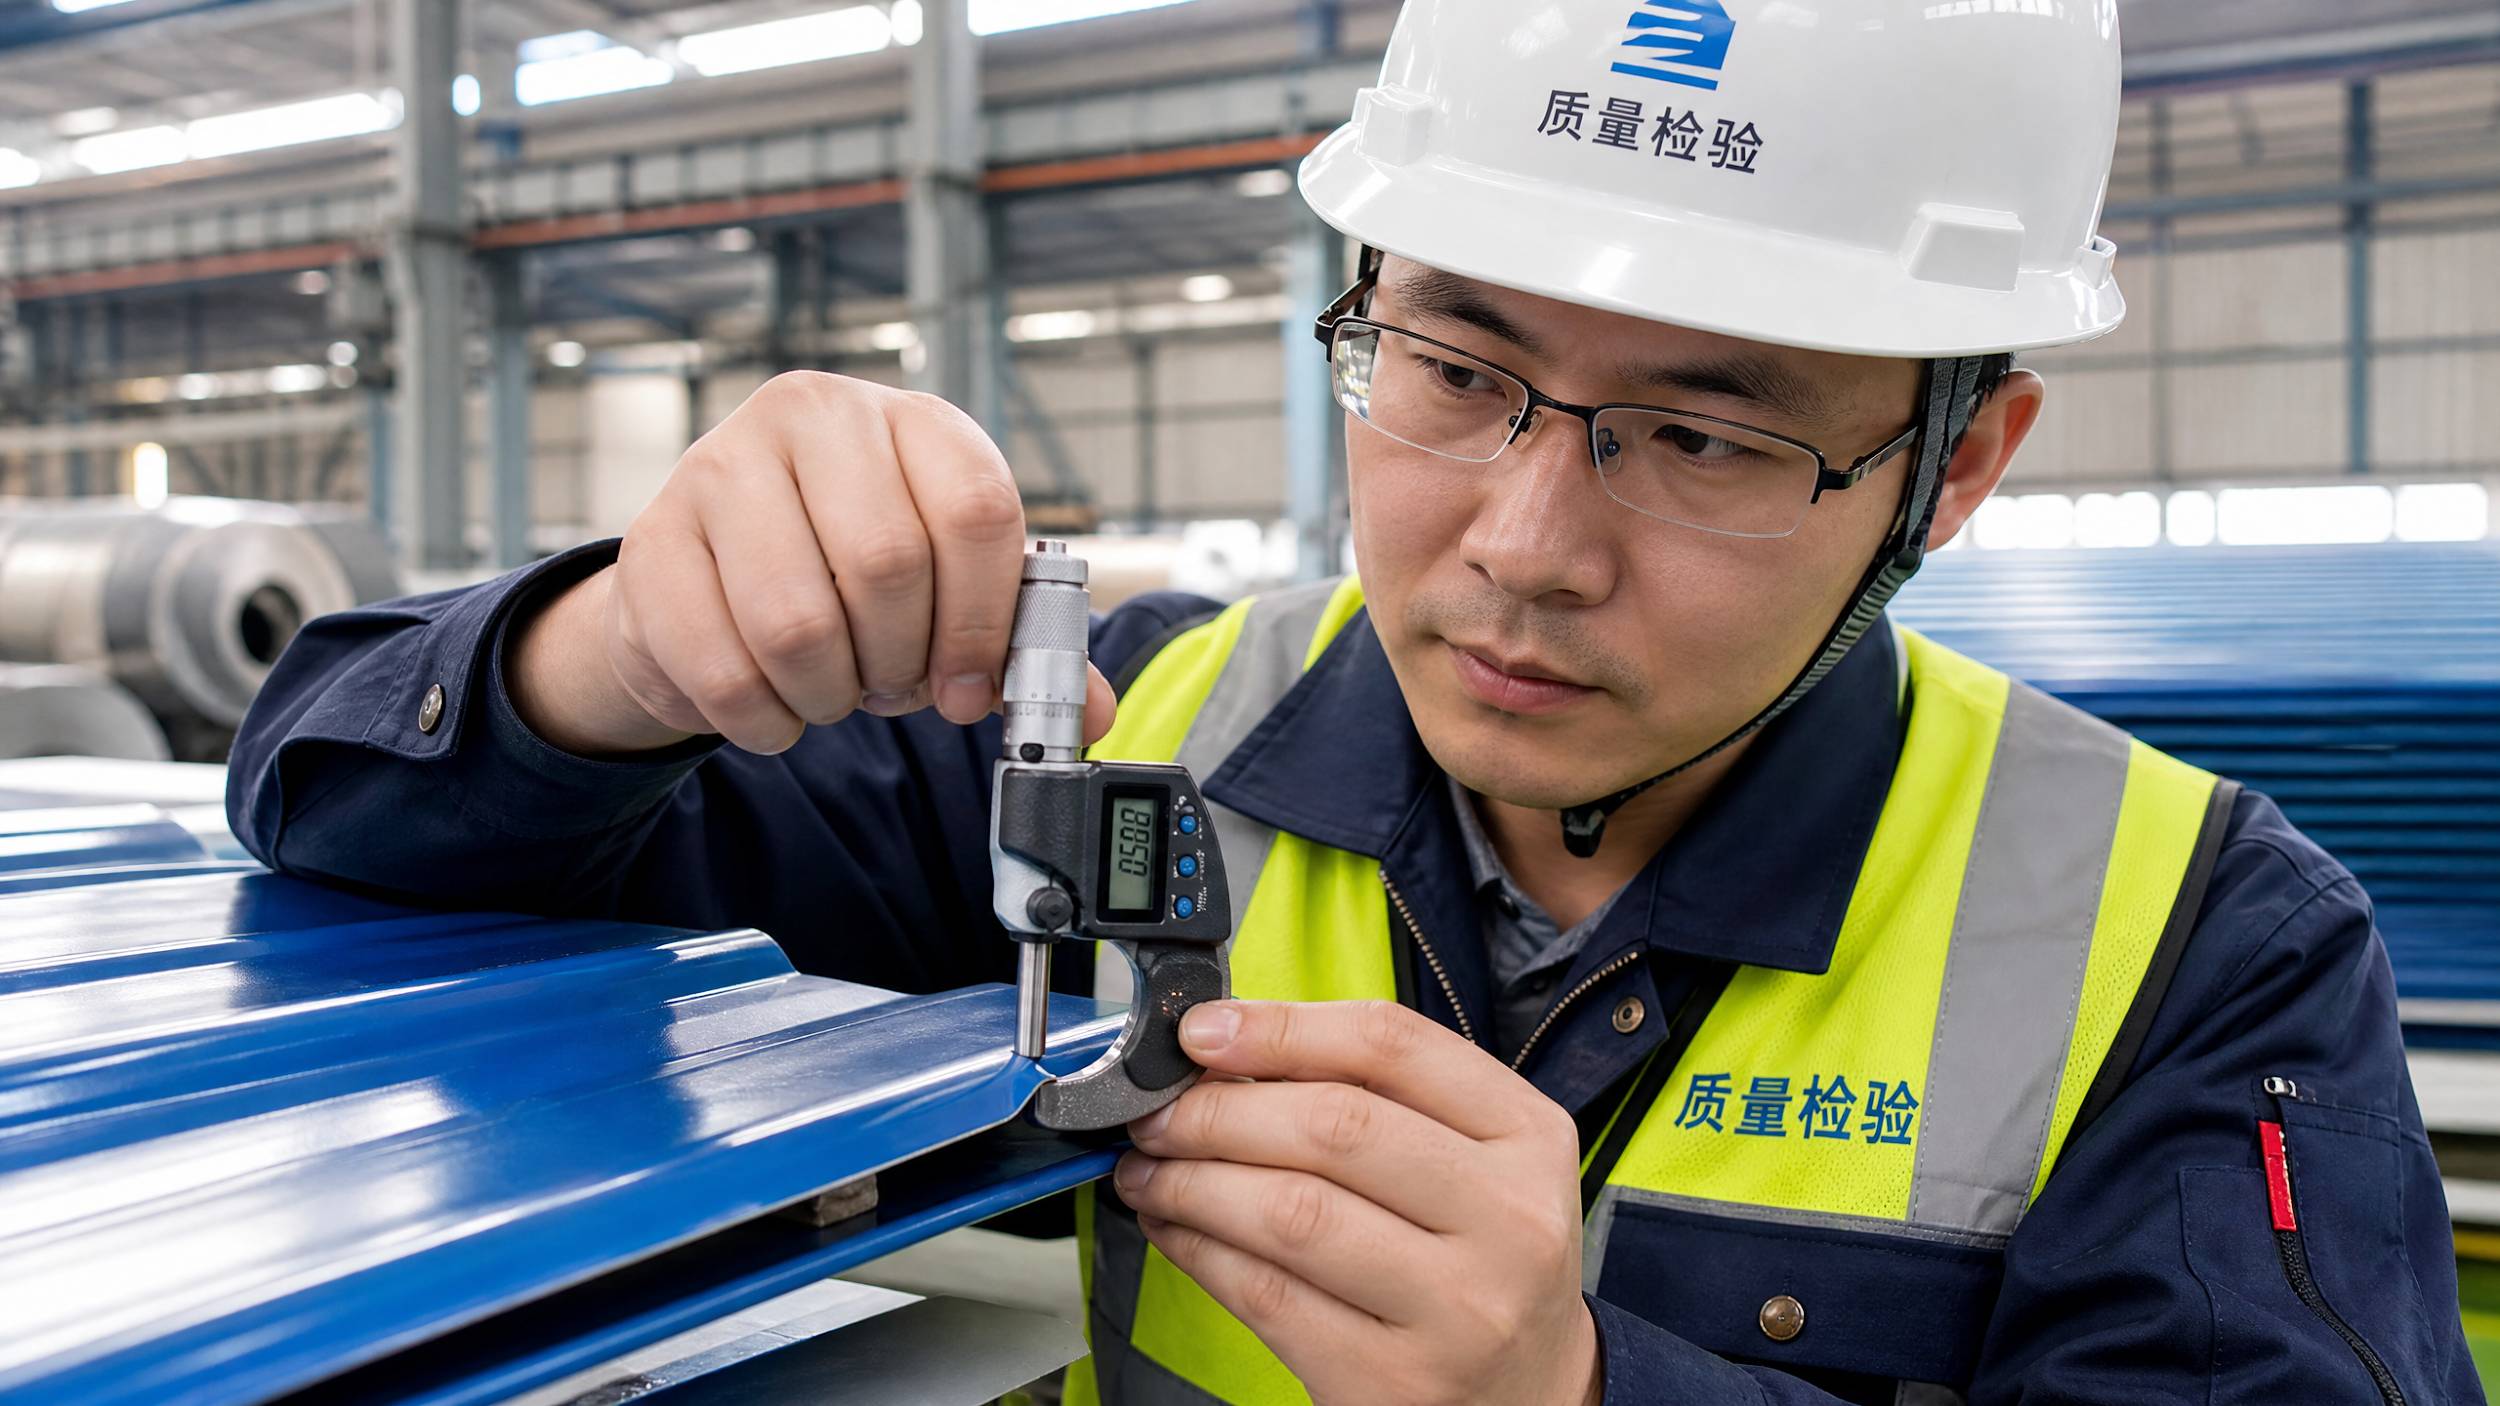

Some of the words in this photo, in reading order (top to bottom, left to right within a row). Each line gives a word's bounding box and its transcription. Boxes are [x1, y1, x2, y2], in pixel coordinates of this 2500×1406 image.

[1537, 89, 1764, 174] 质量检验
[1674, 1072, 1919, 1145] 质量检验
